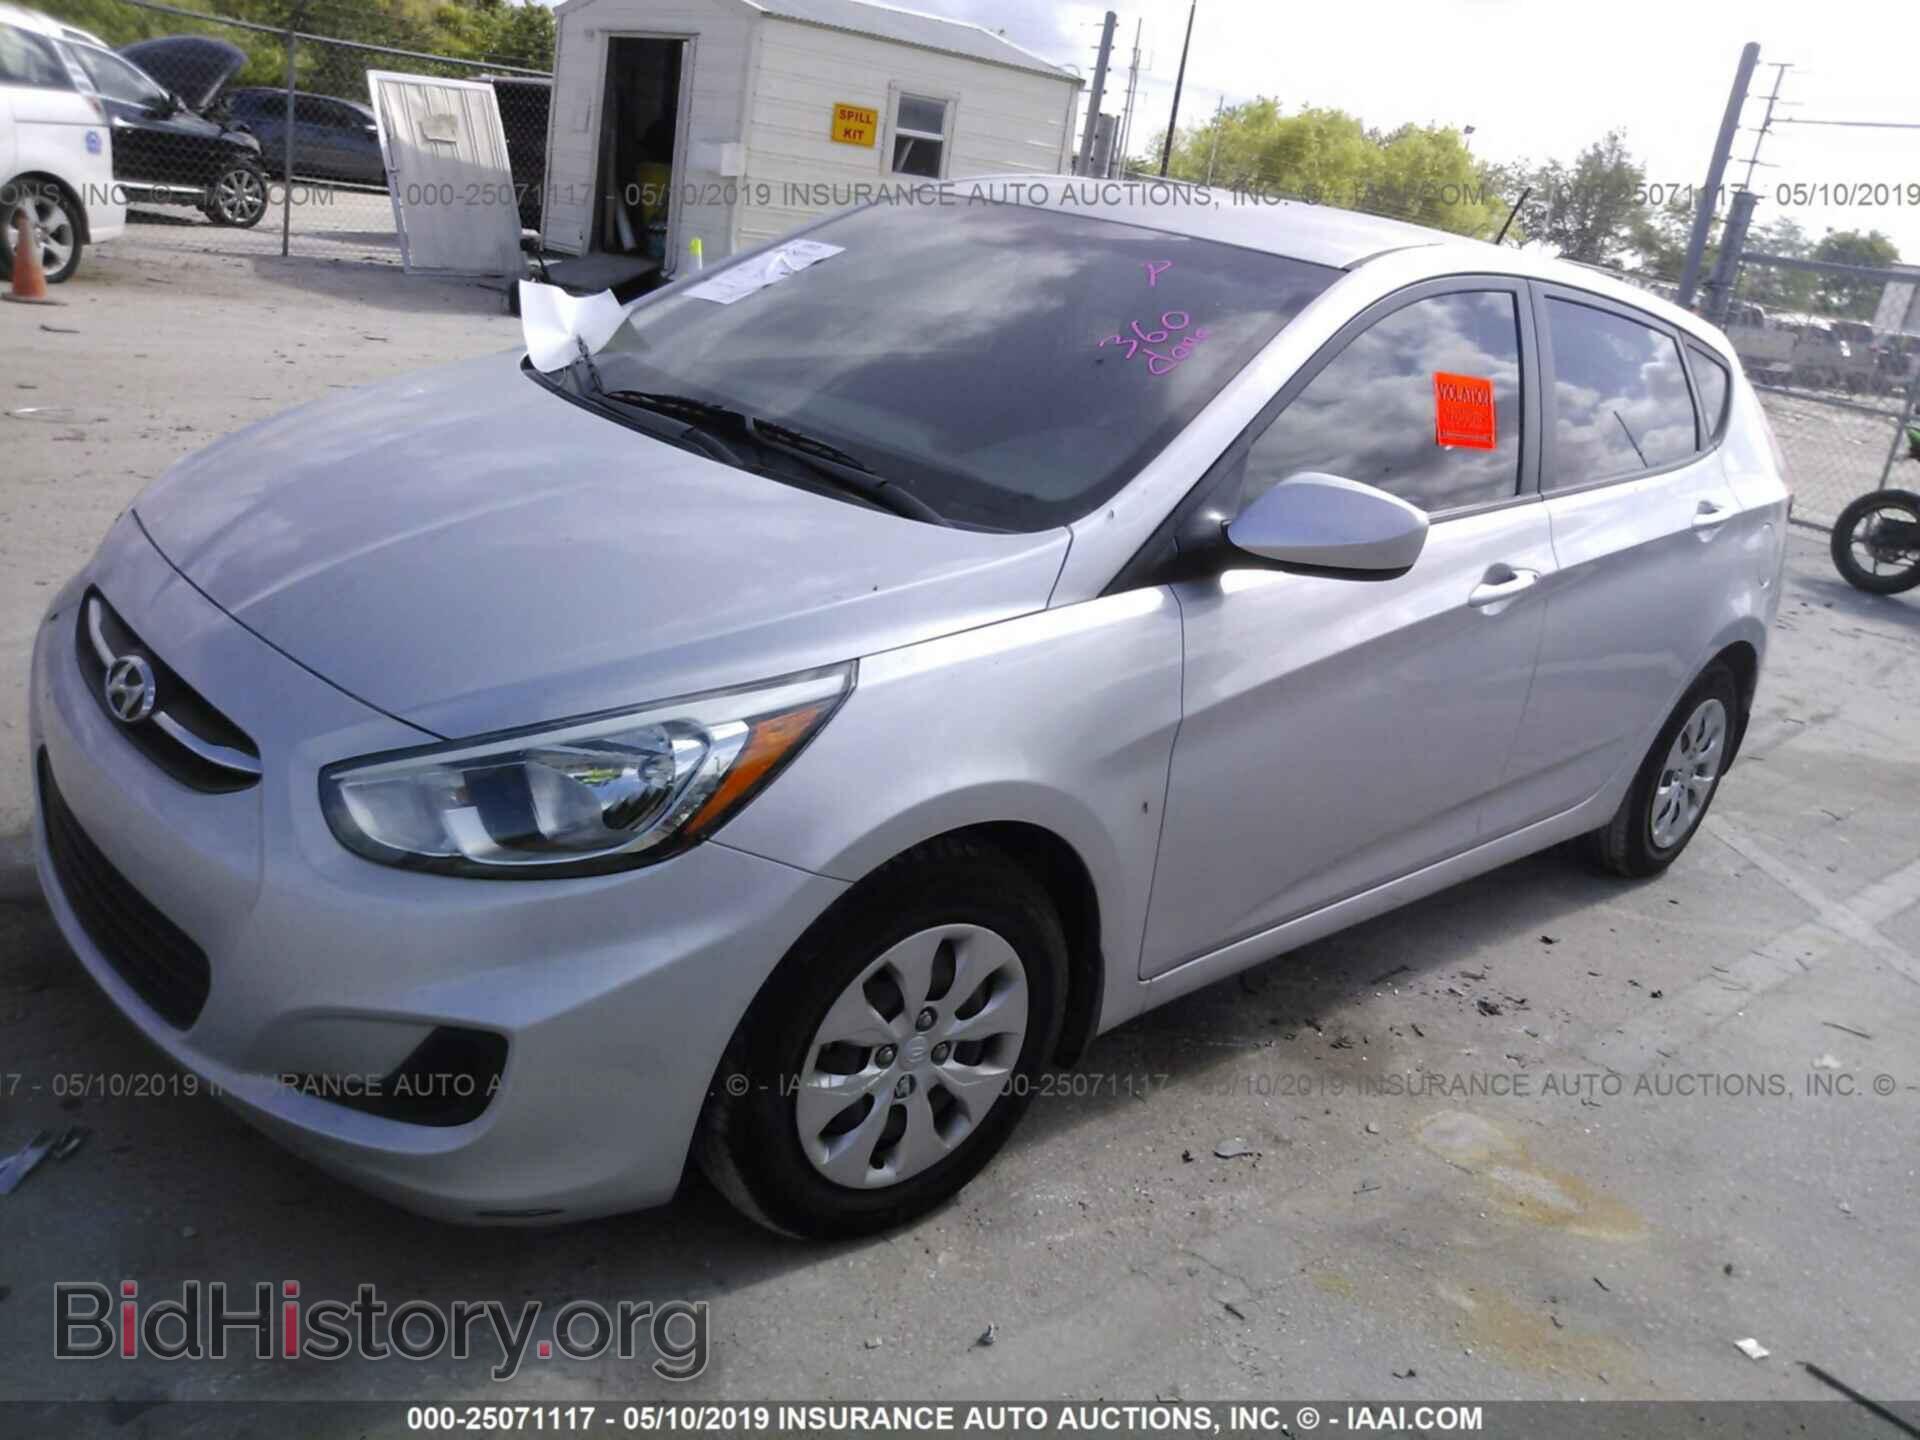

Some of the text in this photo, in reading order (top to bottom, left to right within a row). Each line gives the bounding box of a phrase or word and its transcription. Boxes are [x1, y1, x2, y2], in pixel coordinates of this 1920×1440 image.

[839, 108, 873, 125] SPILL
[843, 127, 865, 141] KIT
[1099, 310, 1190, 360] 360
